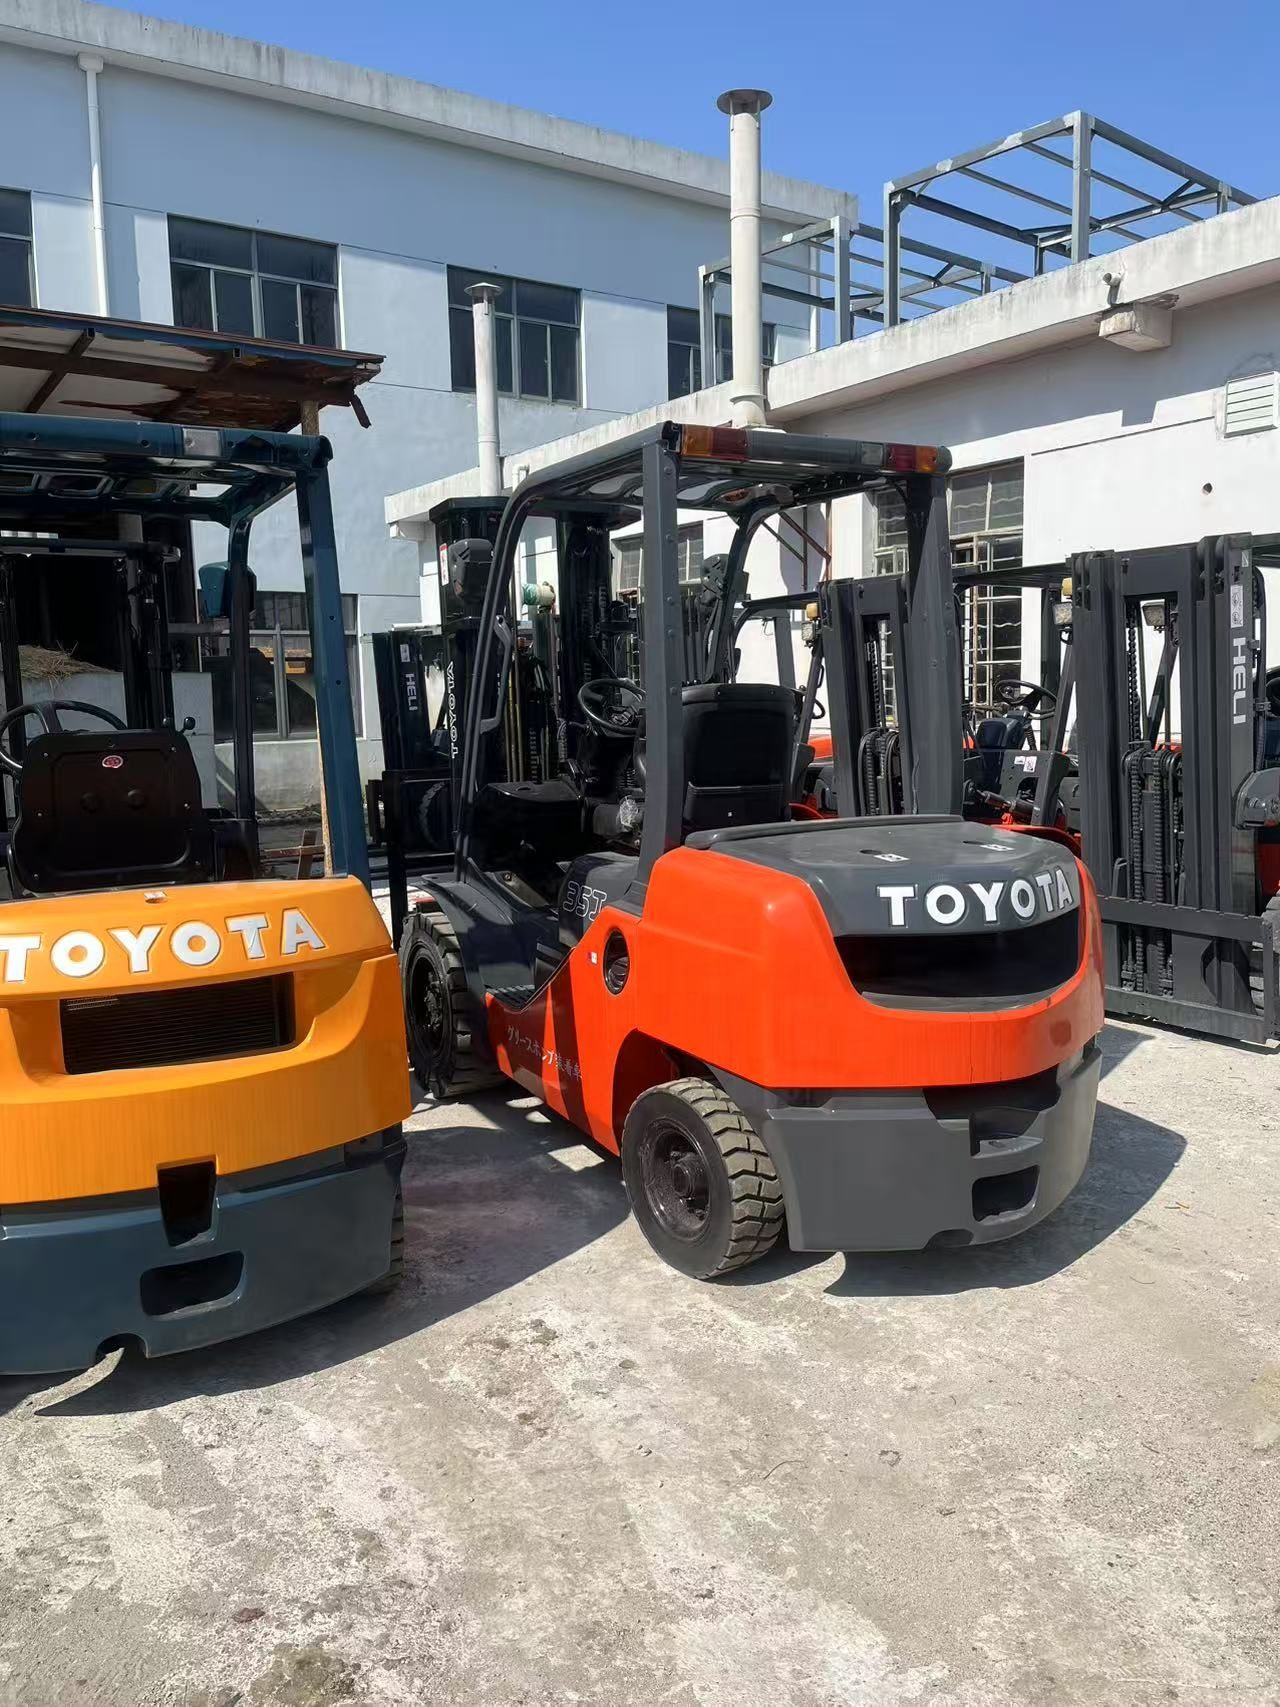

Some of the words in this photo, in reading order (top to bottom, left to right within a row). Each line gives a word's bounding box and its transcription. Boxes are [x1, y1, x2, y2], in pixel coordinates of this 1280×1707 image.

[406, 673, 418, 711] HELI
[447, 661, 458, 759] TOYOTA
[1233, 637, 1246, 724] HELI
[880, 868, 1073, 926] TOYOTA
[0, 907, 326, 982] TOYOTA
